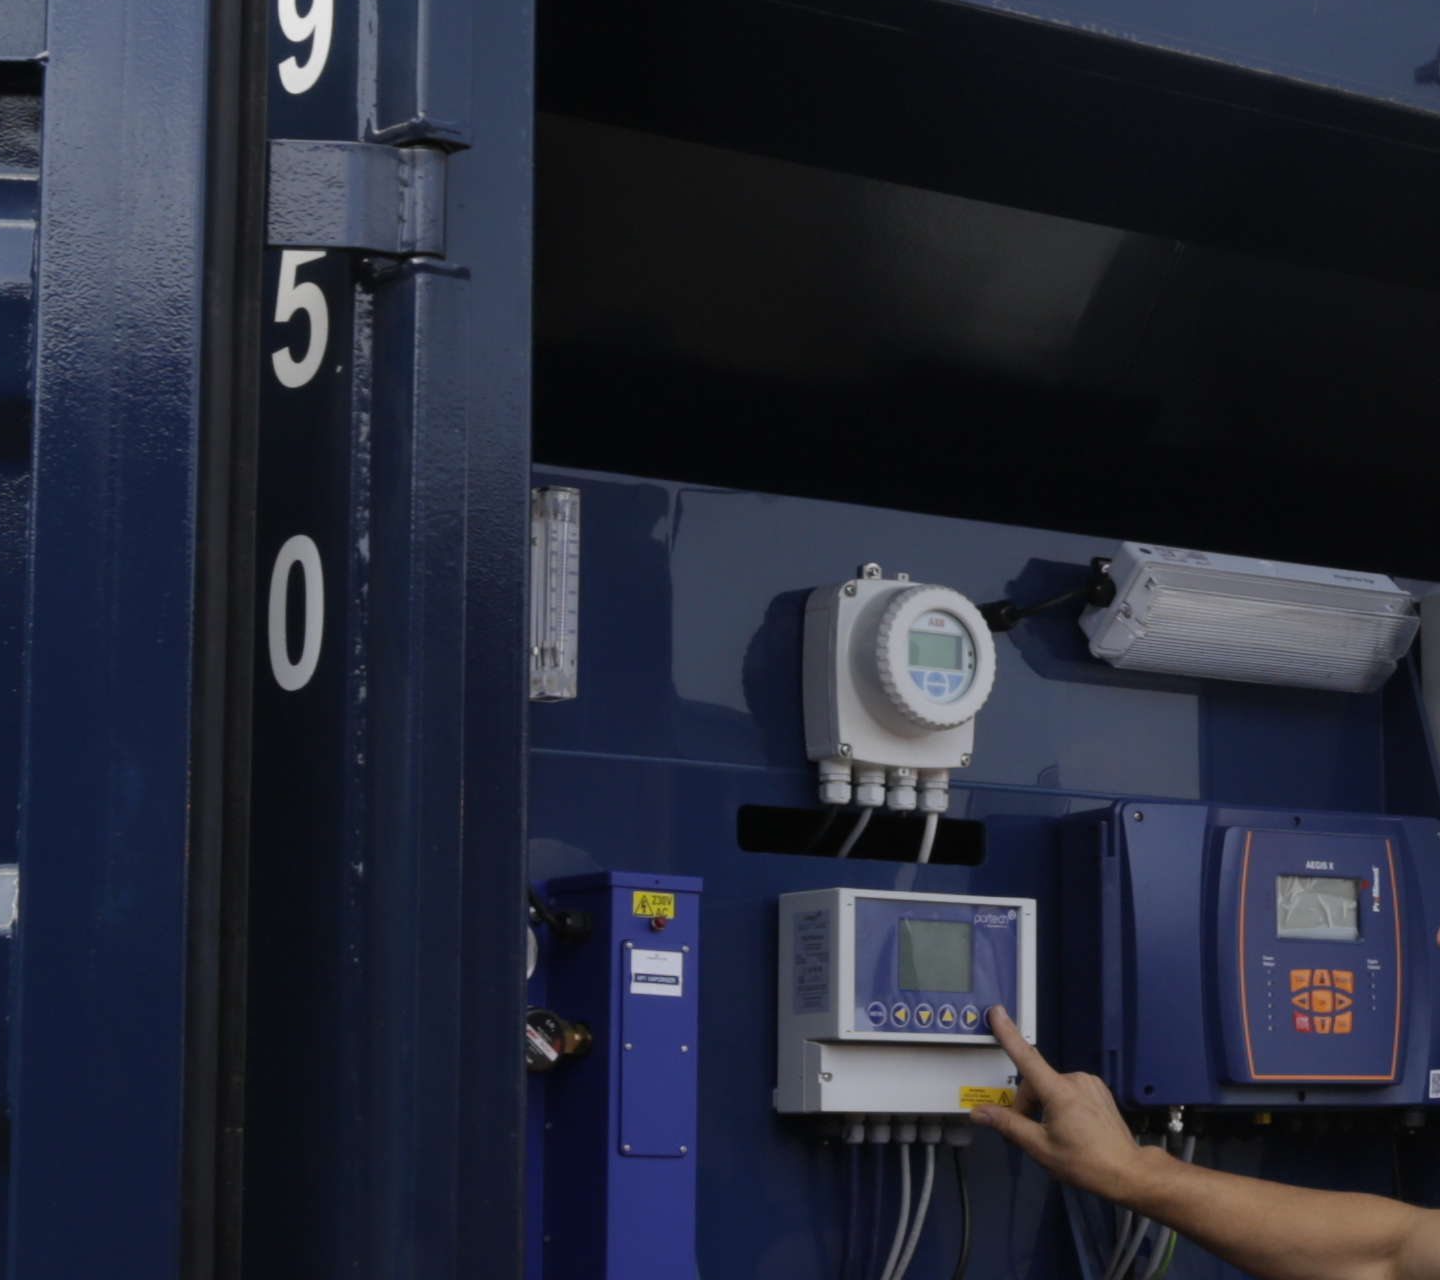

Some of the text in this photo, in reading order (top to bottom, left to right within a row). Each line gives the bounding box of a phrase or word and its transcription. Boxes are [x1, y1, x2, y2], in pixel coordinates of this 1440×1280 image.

[1305, 860, 1327, 870] AEGIS
[651, 895, 672, 906] 230V
[656, 907, 669, 918] AC
